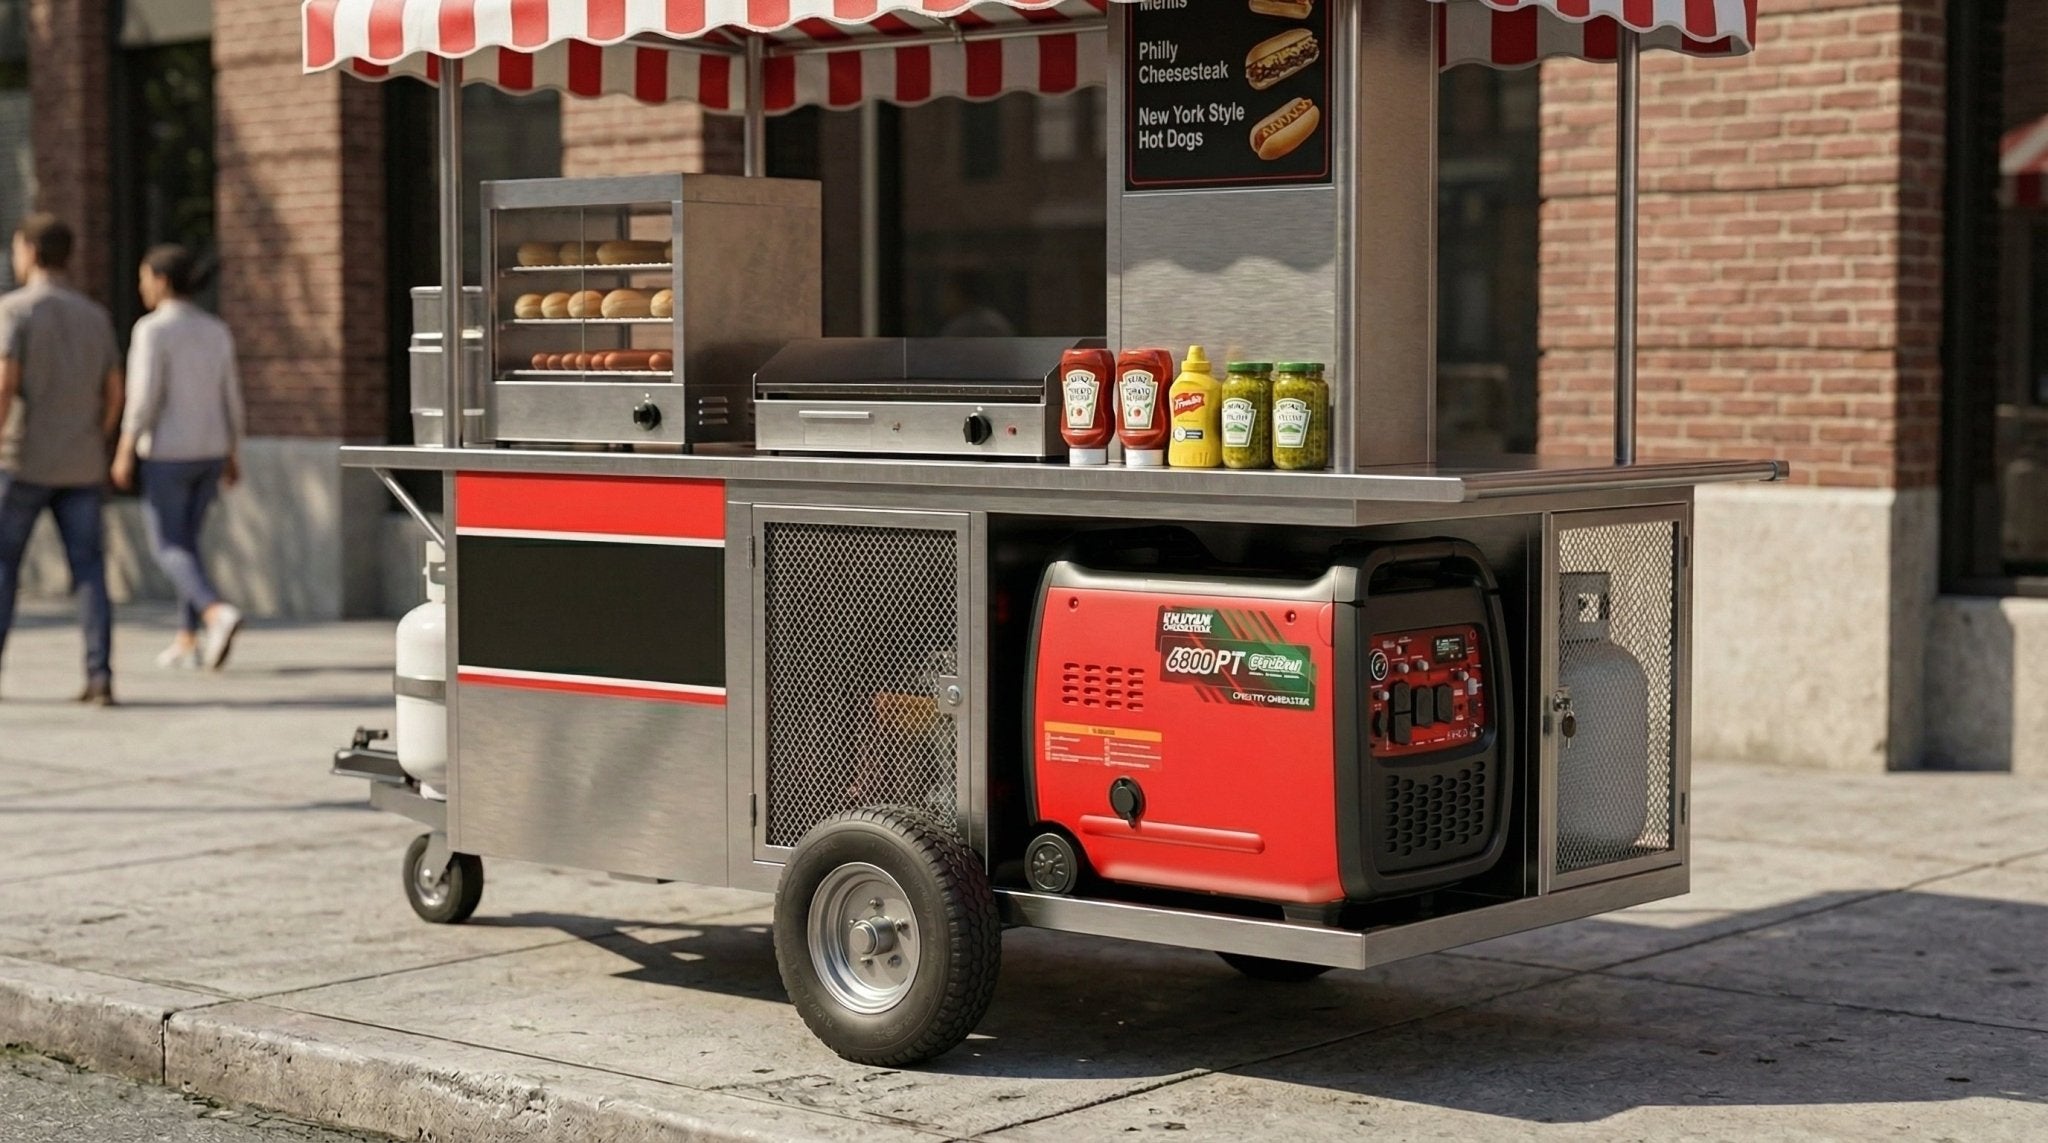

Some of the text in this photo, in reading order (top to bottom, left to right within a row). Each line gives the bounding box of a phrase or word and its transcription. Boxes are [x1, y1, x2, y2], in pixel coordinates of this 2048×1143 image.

[1139, 40, 1178, 64] Philly
[1139, 61, 1229, 84] Cheesesteak
[1139, 102, 1245, 126] New York Style
[1139, 129, 1204, 152] Hot Dogs
[1165, 646, 1247, 676] 6800PT
